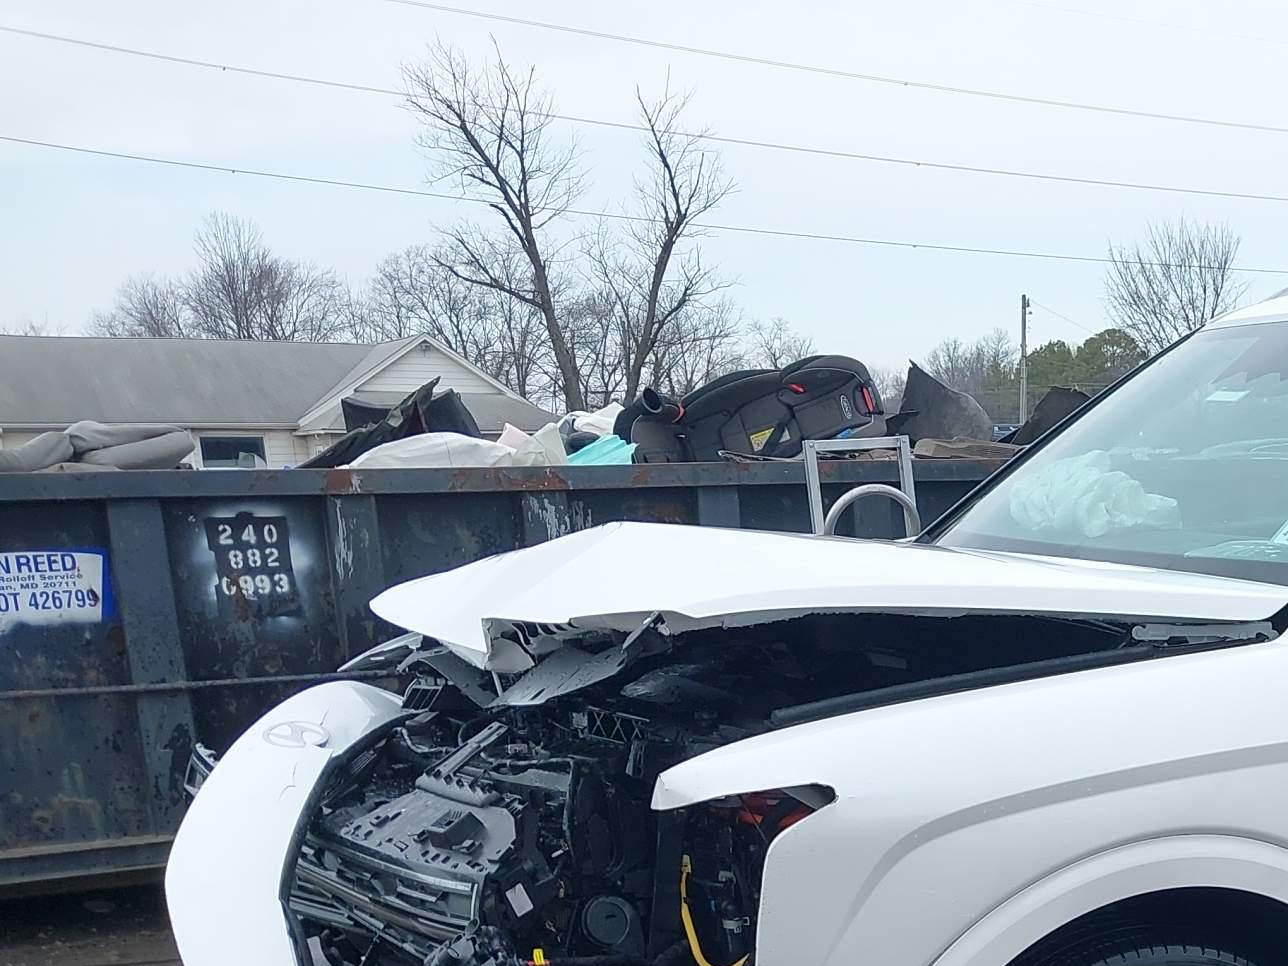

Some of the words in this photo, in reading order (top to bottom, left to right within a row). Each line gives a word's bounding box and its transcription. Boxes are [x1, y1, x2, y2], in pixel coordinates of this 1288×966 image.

[228, 547, 280, 569] 882
[39, 573, 84, 581] Service
[42, 580, 77, 589] 20711
[29, 587, 100, 611] 426799
